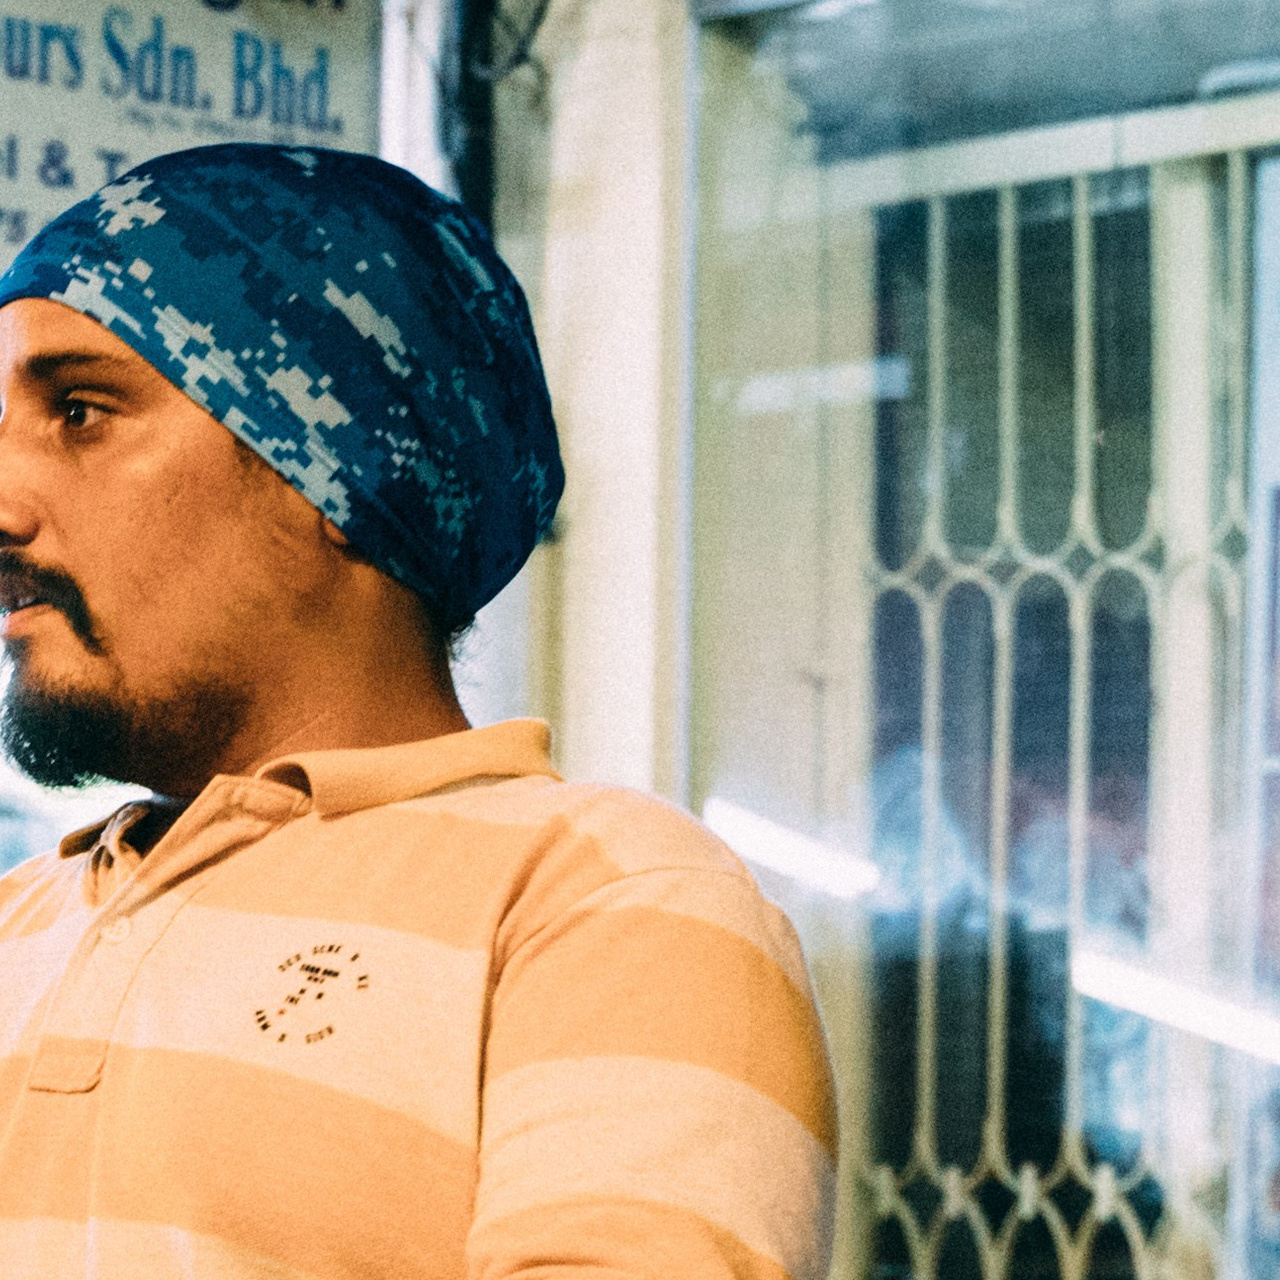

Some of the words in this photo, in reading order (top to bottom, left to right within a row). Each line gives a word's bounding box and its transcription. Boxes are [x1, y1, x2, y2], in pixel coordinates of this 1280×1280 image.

[99, 6, 214, 113] Sdn.
[232, 29, 344, 135] Bhd.
[37, 139, 76, 189] &
